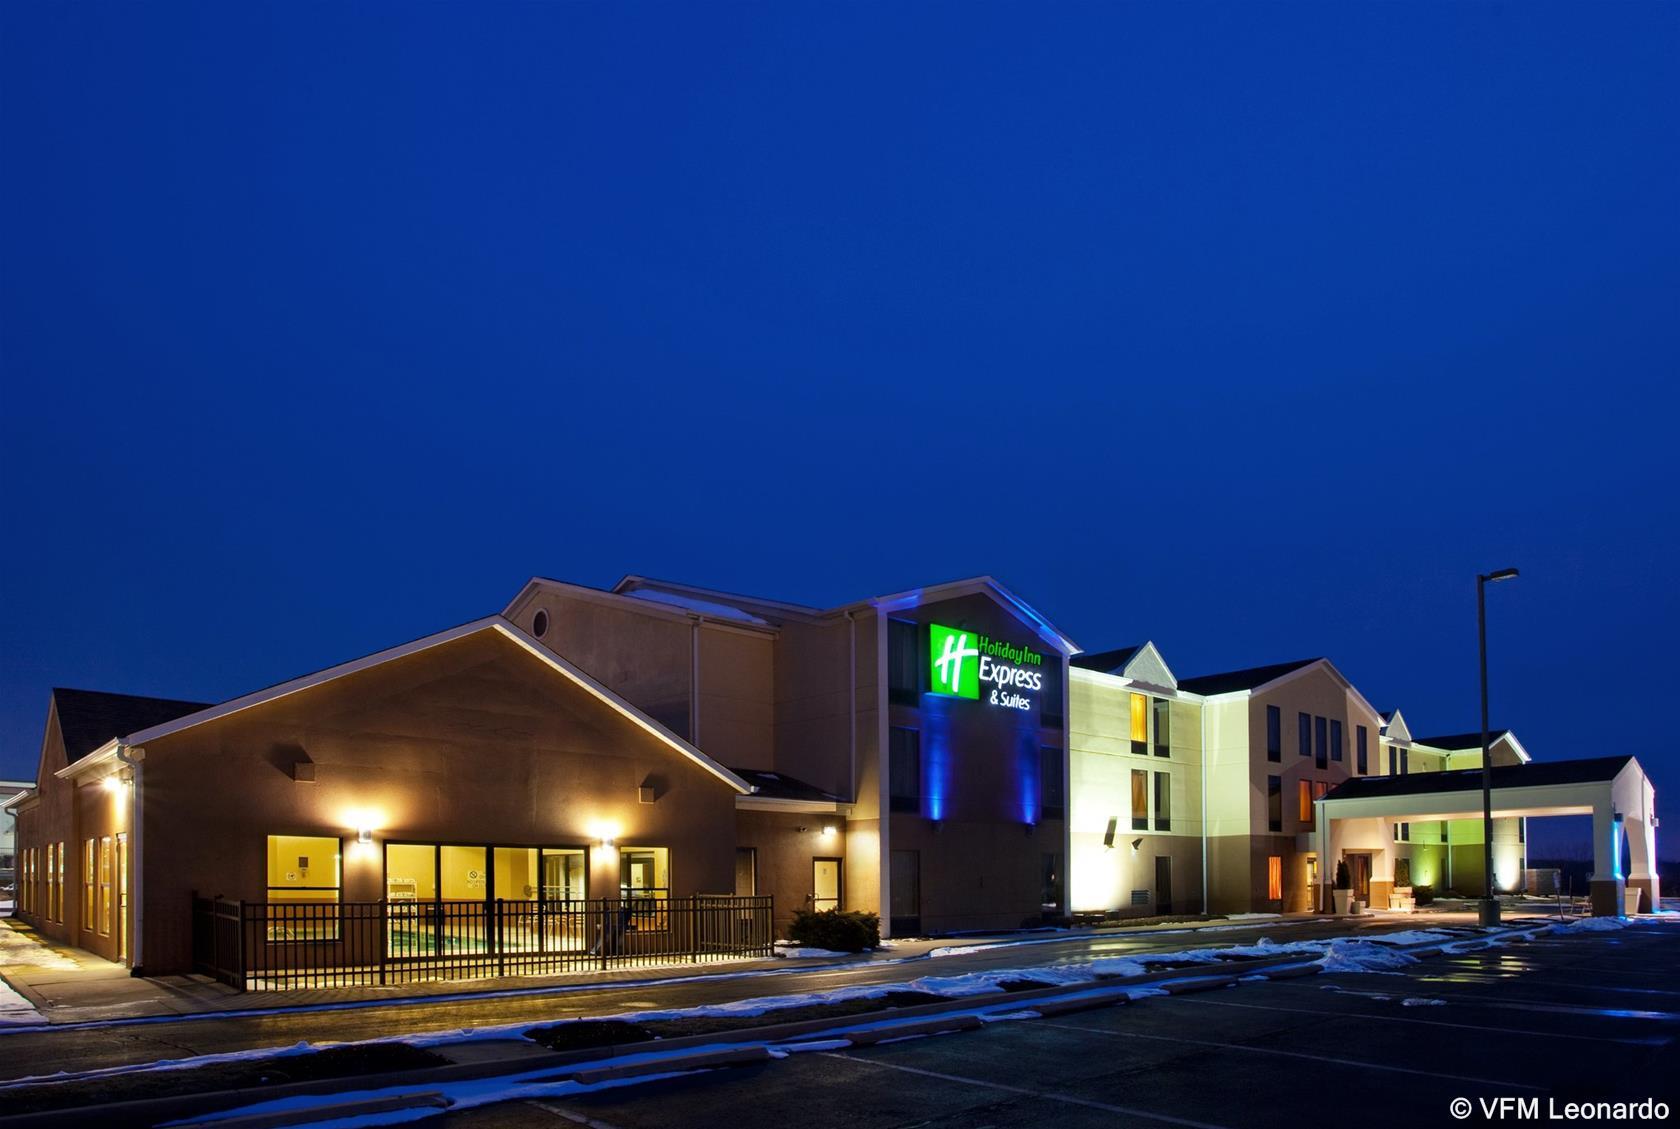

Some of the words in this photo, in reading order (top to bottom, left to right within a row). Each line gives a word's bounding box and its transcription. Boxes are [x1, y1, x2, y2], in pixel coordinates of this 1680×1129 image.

[979, 656, 1042, 691] Express
[990, 689, 999, 705] &
[1000, 691, 1031, 711] Suites
